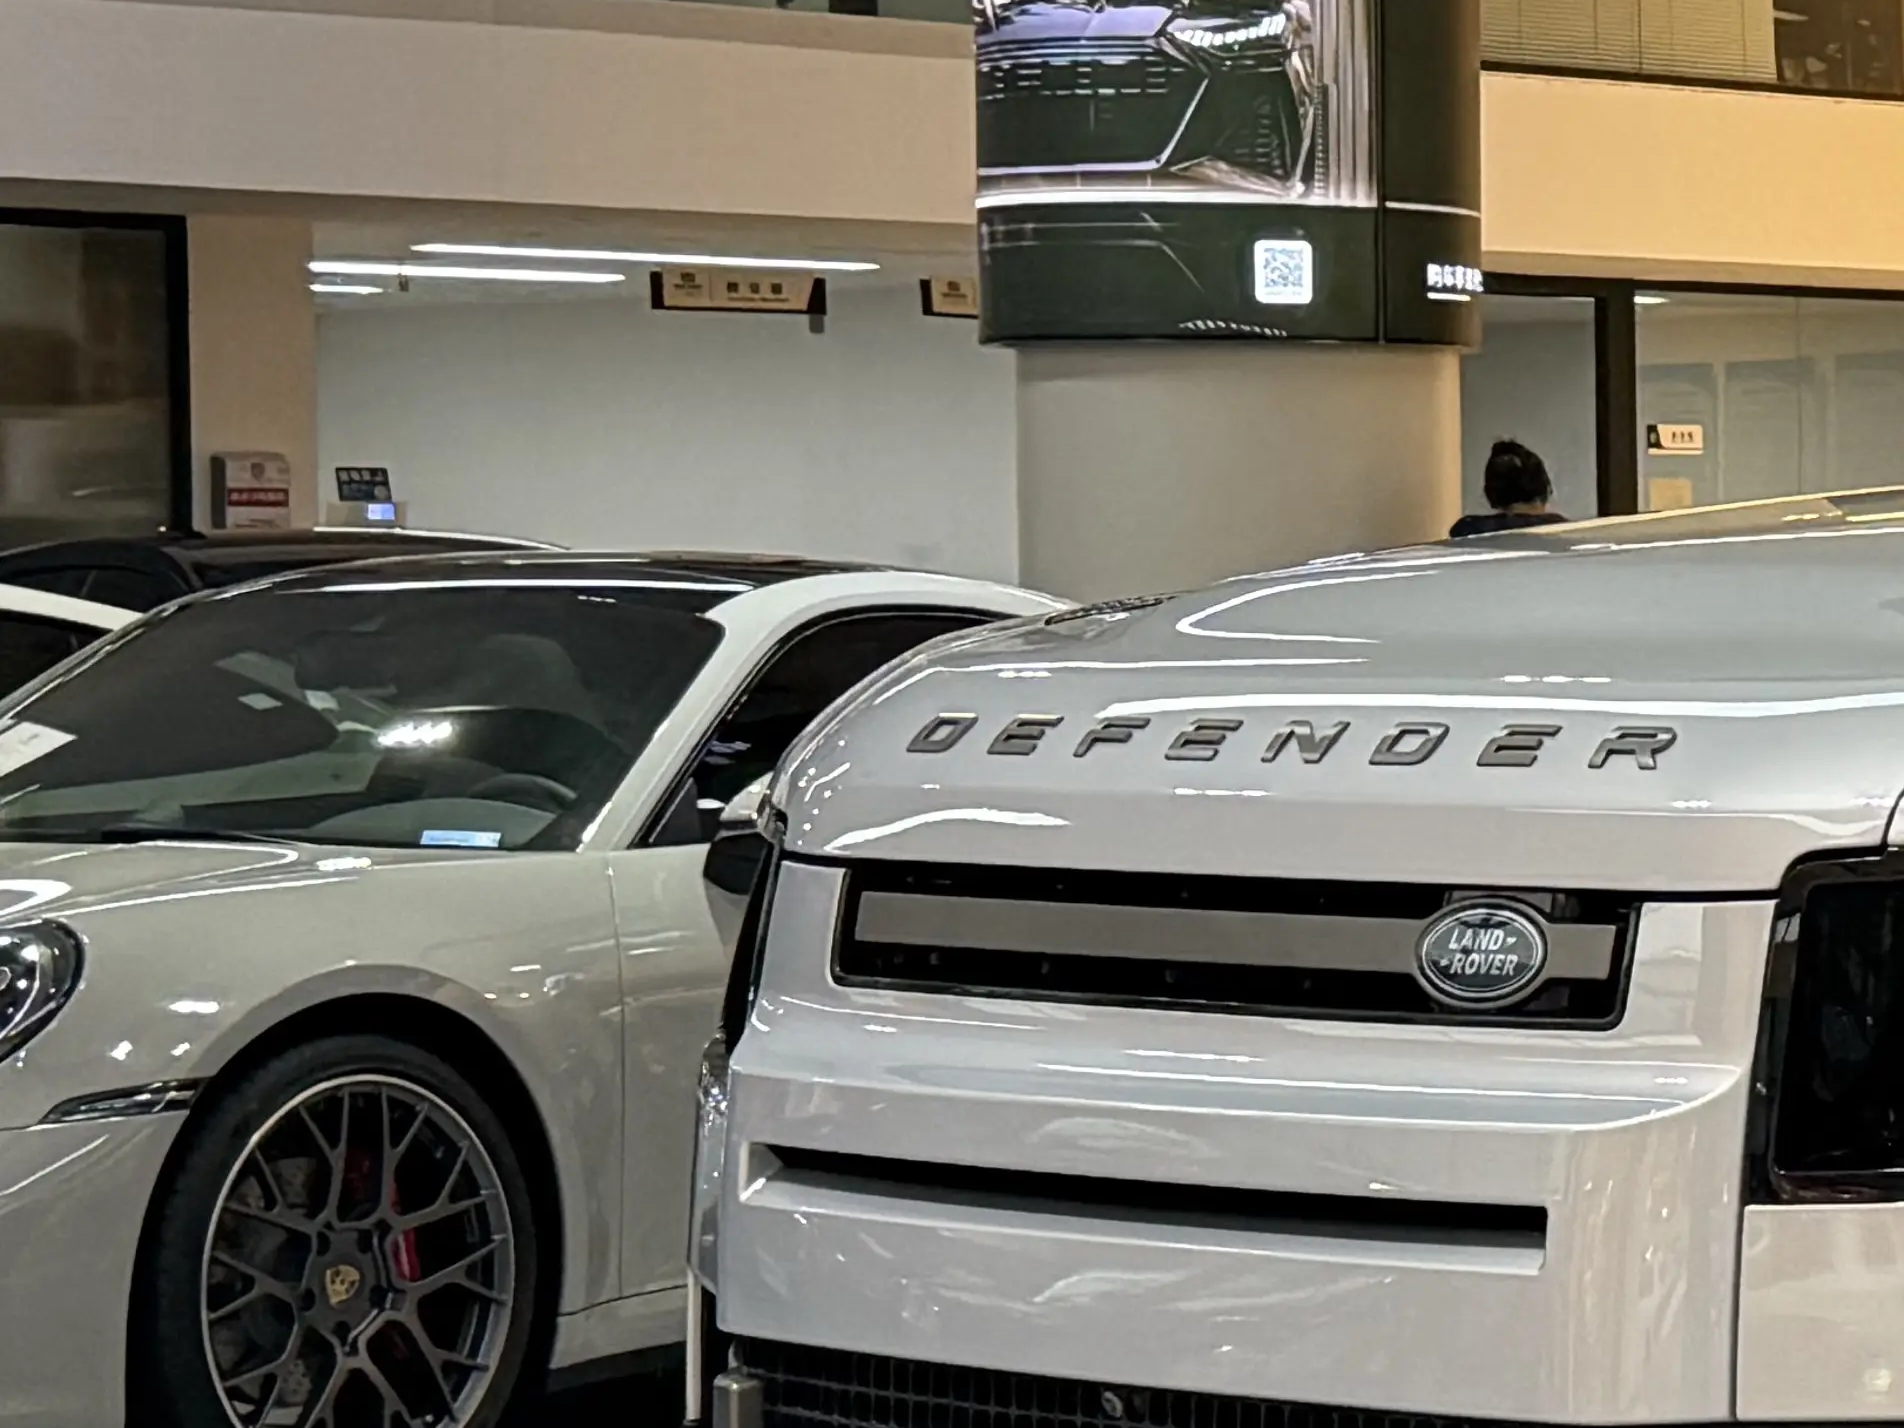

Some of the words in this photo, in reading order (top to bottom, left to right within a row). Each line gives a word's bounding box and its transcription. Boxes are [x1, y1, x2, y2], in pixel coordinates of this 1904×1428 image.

[906, 712, 1678, 770] DEFENDER
[1448, 928, 1505, 951] LAND
[1450, 953, 1519, 976] ROVER
